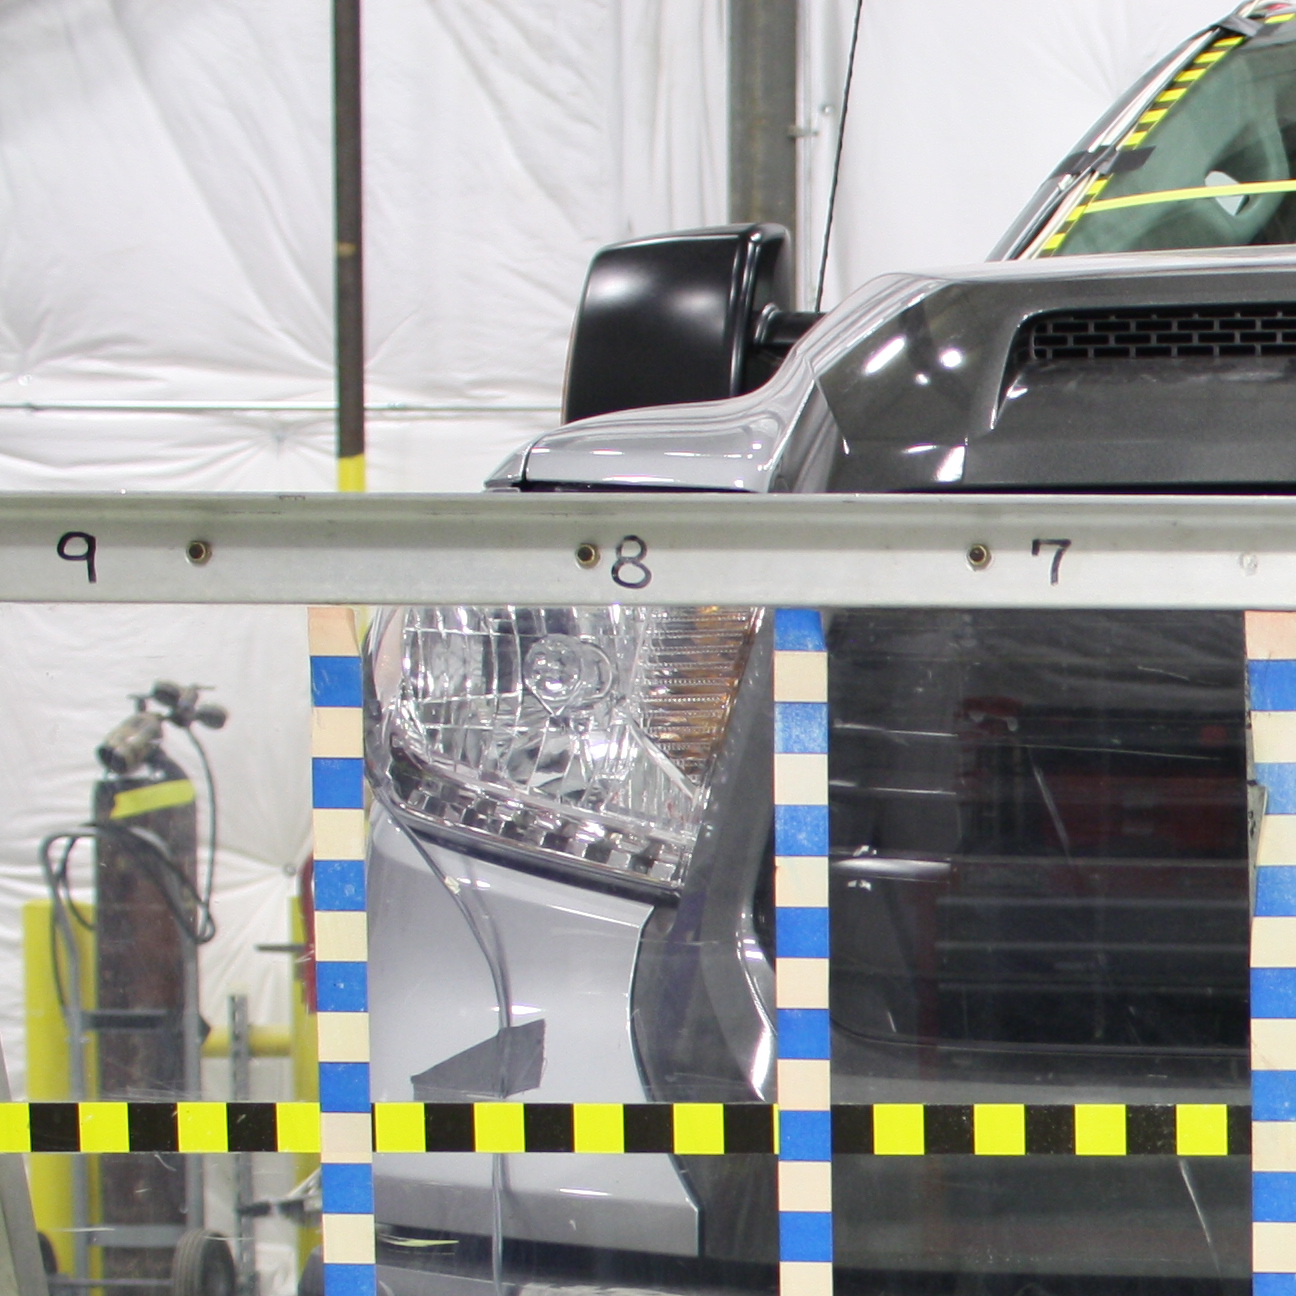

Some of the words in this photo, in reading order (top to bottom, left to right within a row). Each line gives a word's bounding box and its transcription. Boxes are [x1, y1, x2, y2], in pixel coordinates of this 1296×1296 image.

[57, 531, 97, 583] 9
[611, 535, 651, 589] 8
[1031, 537, 1072, 586] 7
